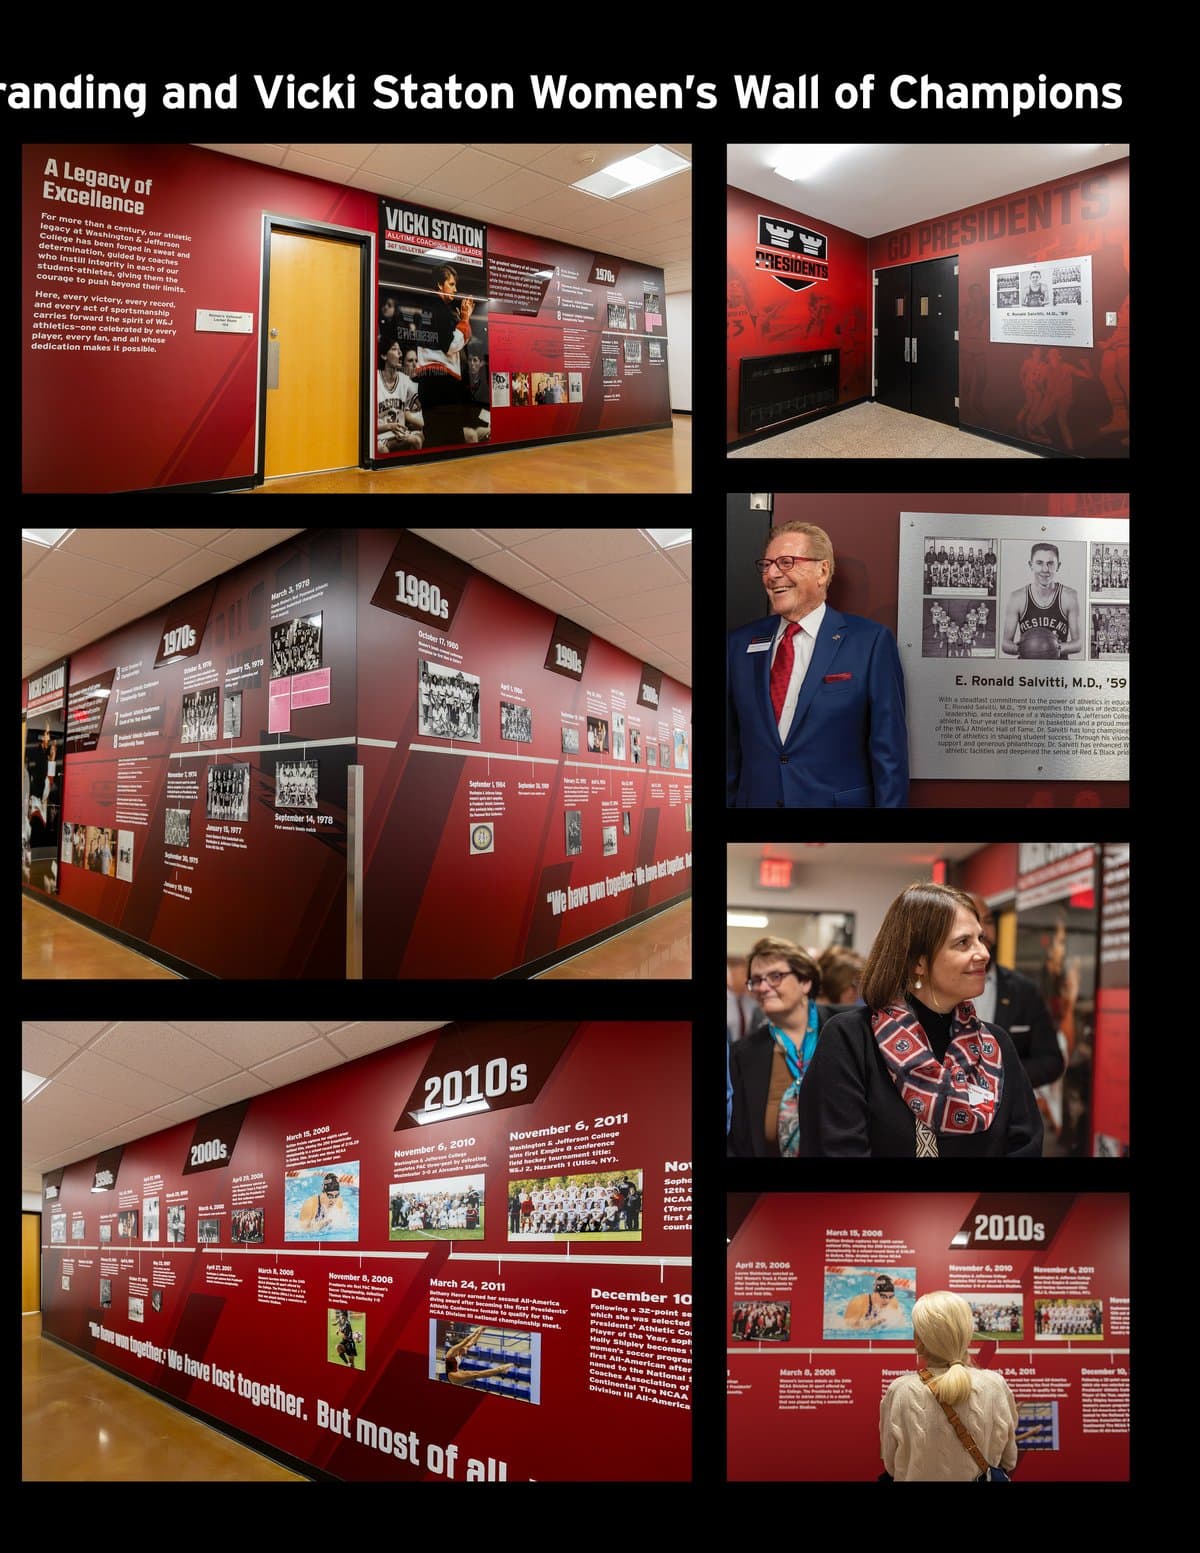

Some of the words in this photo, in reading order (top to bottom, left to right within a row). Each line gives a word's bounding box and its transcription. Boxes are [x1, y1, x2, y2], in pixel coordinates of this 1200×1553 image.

[44, 158, 58, 176] A
[64, 162, 130, 193] Legacy
[134, 179, 152, 195] of
[43, 180, 144, 215] Excellence
[385, 206, 430, 238] VICKI
[432, 218, 483, 249] STATON
[887, 238, 911, 261] GO
[918, 175, 1111, 255] PRESIDENTS
[595, 267, 615, 283] 1970s
[755, 251, 829, 279] PRESIDENTS
[395, 570, 449, 620] 1980s
[163, 624, 197, 657] 1970s
[555, 643, 582, 674] 1990s
[955, 675, 967, 685] E.
[972, 675, 1014, 686] Ronald
[1019, 676, 1067, 688] Salvitti,
[1072, 677, 1101, 689] M.D.,
[1107, 678, 1126, 688] '59
[275, 813, 304, 822] September
[306, 815, 315, 824] 14,
[317, 816, 332, 824] 1978
[424, 1057, 527, 1112] 2010s
[510, 1125, 570, 1141] November
[575, 1120, 588, 1130] 6,
[594, 1113, 627, 1128] 2011
[191, 1139, 230, 1166] 2000s
[394, 1145, 435, 1158] November
[437, 1142, 447, 1150] 6,
[450, 1137, 475, 1149] 2010
[509, 1142, 545, 1151] Washington
[555, 1136, 589, 1146] Jefferson
[974, 1214, 1045, 1241] 2010s
[736, 1262, 753, 1271] April
[430, 1278, 457, 1287] March
[461, 1280, 477, 1290] 24,
[481, 1282, 505, 1291] 2011
[591, 1288, 667, 1302] December
[100, 1325, 115, 1344] have
[115, 1332, 129, 1351] won
[168, 1348, 182, 1371] We
[184, 1353, 210, 1382] have
[212, 1363, 235, 1393] lost
[238, 1372, 308, 1421] together.
[317, 1398, 351, 1439] But
[357, 1417, 420, 1466] most
[427, 1443, 459, 1479] of
[466, 1458, 507, 1482] all
